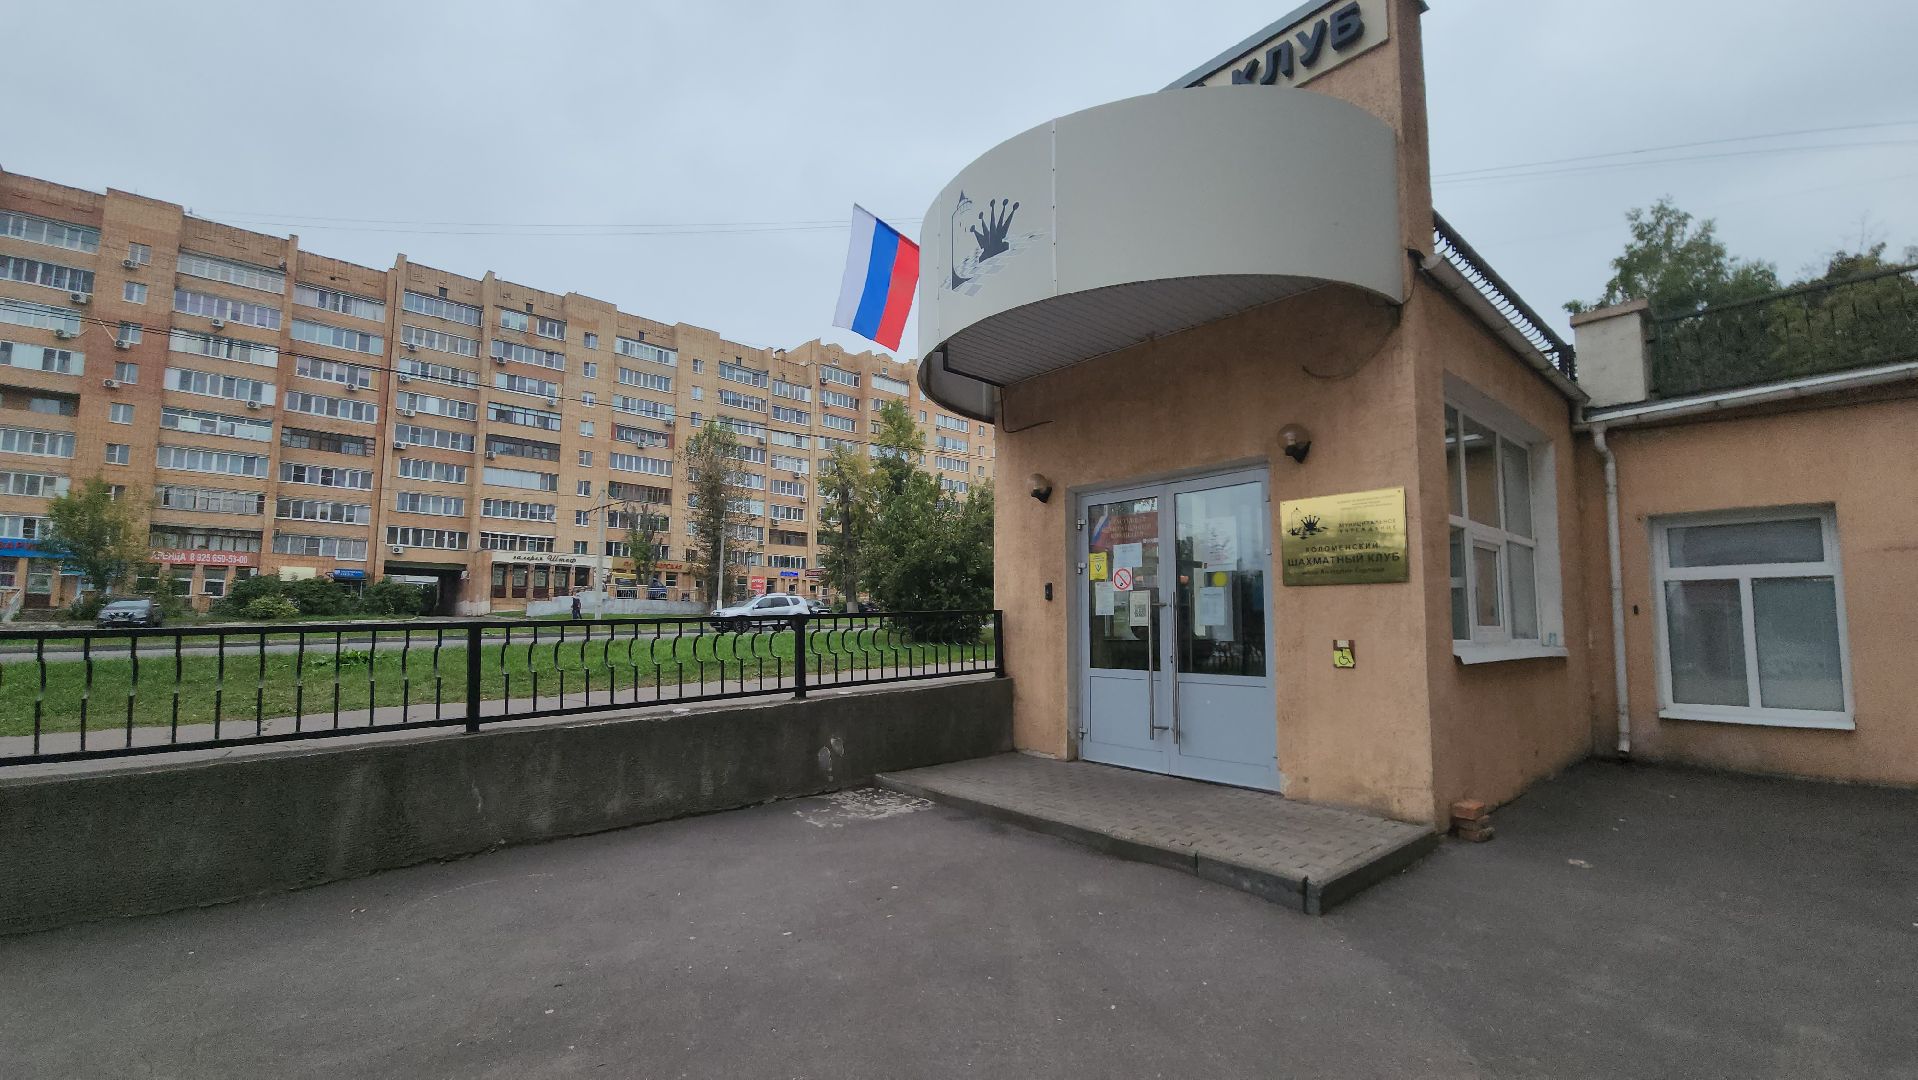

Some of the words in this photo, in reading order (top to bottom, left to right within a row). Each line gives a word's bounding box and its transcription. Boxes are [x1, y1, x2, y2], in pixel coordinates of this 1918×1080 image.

[1232, 1, 1364, 85] КЛУБ
[190, 553, 195, 561] 8
[197, 553, 210, 562] 925
[1287, 553, 1364, 567] ШАХМАТНЫЙ
[1367, 552, 1400, 563] КЛУБ
